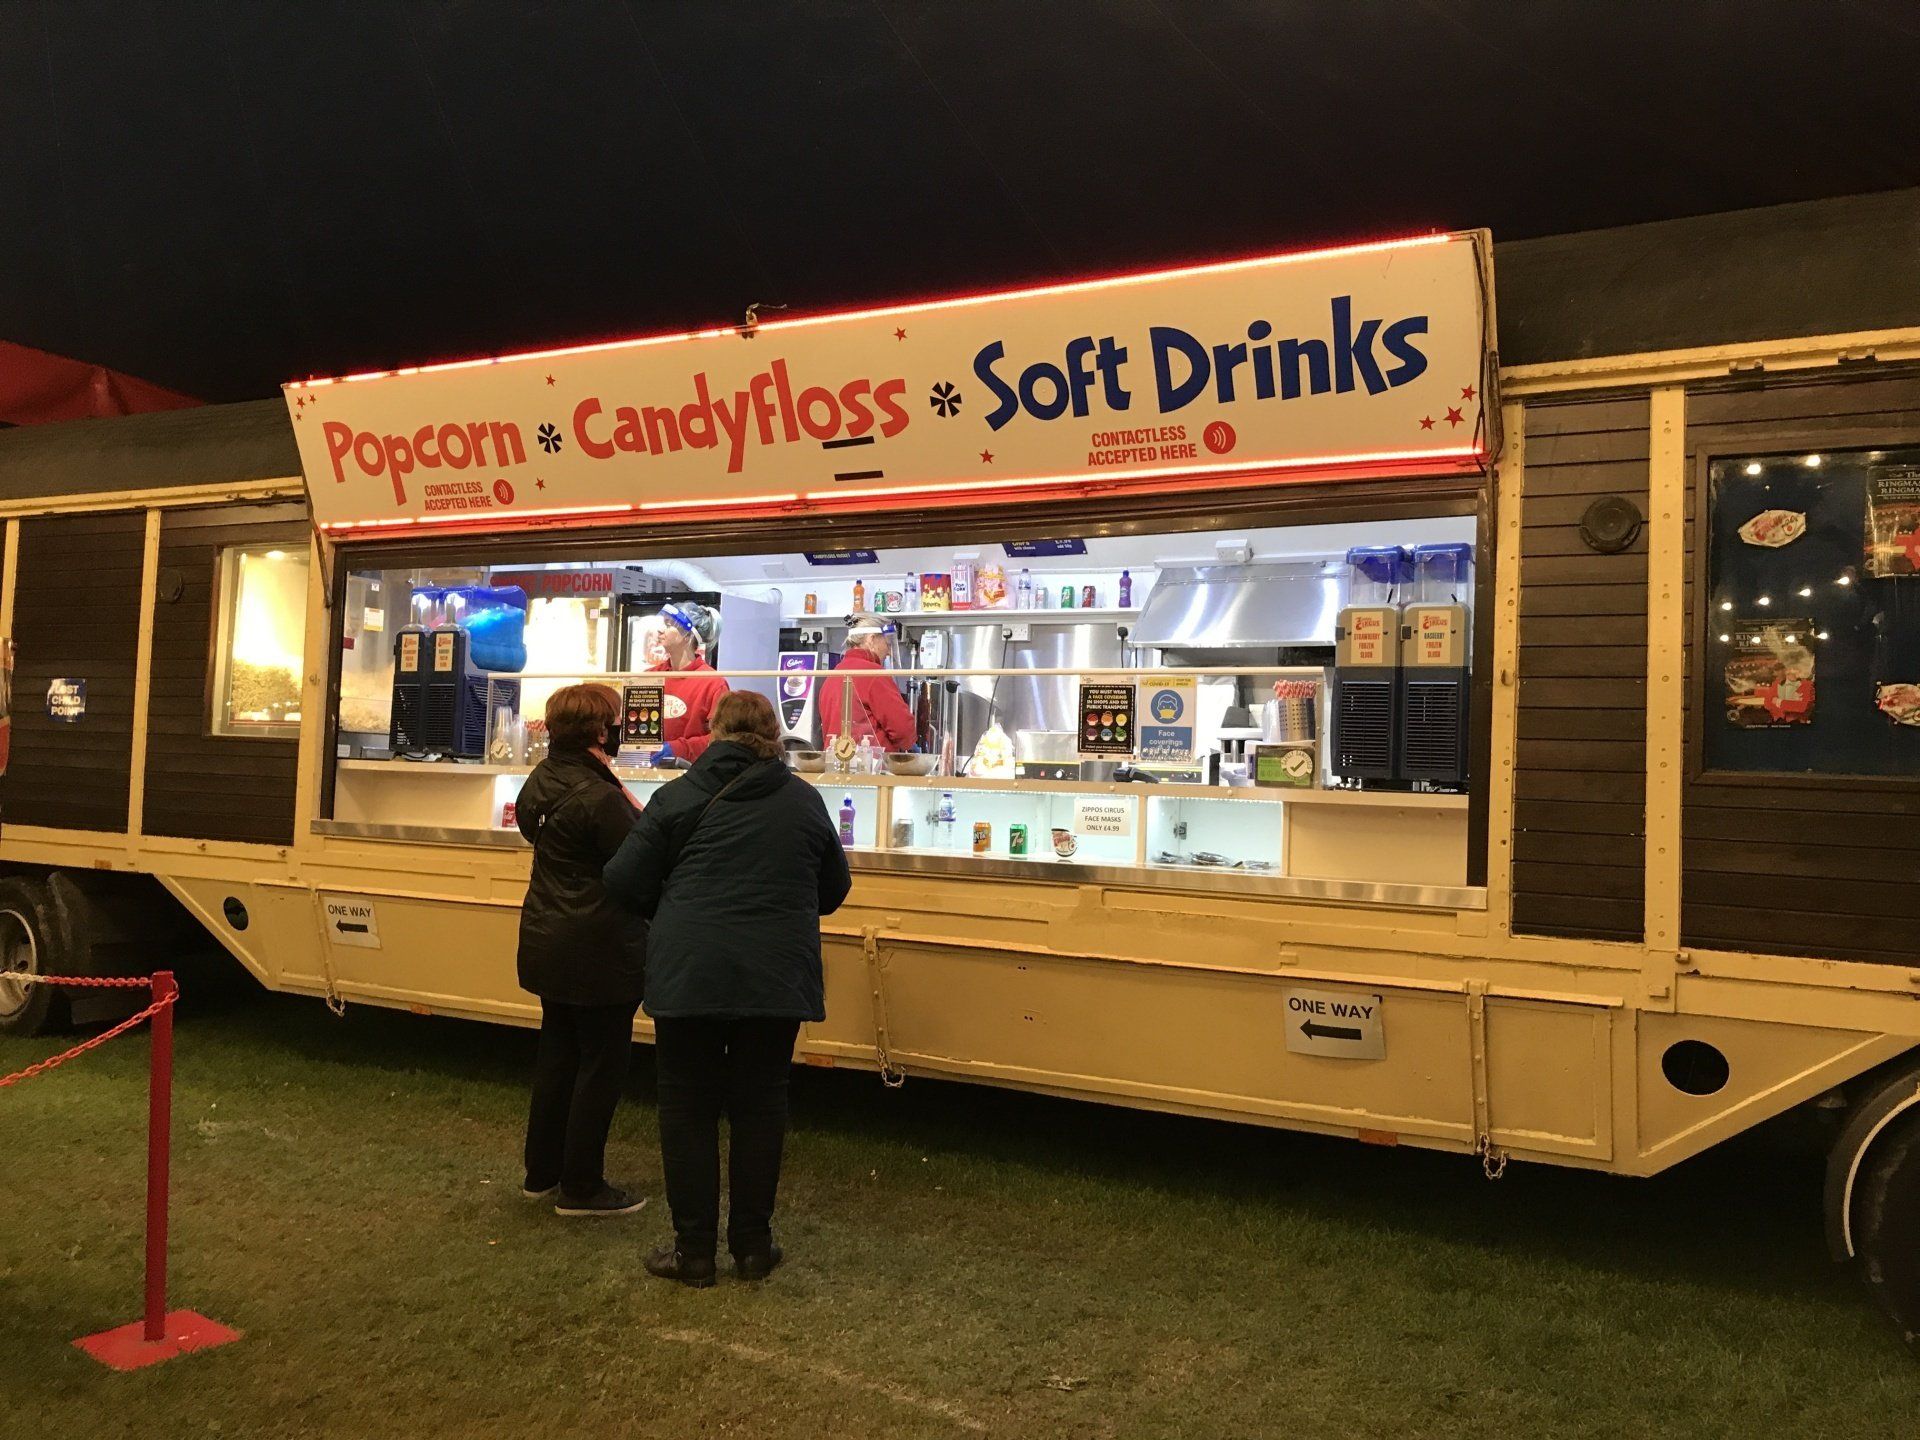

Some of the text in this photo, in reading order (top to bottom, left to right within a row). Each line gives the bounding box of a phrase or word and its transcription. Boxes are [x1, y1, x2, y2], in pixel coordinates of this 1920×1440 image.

[322, 295, 1429, 506] Popcorn Candyfloss Soft Drinks
[1091, 425, 1187, 448] CONTACTLESS
[1087, 443, 1198, 467] ACCEPTED HERE
[424, 481, 484, 497] CONTACTLESS
[424, 496, 493, 511] ACCEPTED HERE
[542, 573, 614, 593] POPCORN
[54, 685, 80, 695] LOST
[51, 696, 81, 705] CHILD
[50, 706, 82, 716] POINT
[1148, 739, 1184, 747] coverings
[328, 904, 371, 918] ONE WAY
[1288, 997, 1374, 1020] ONE WAY
